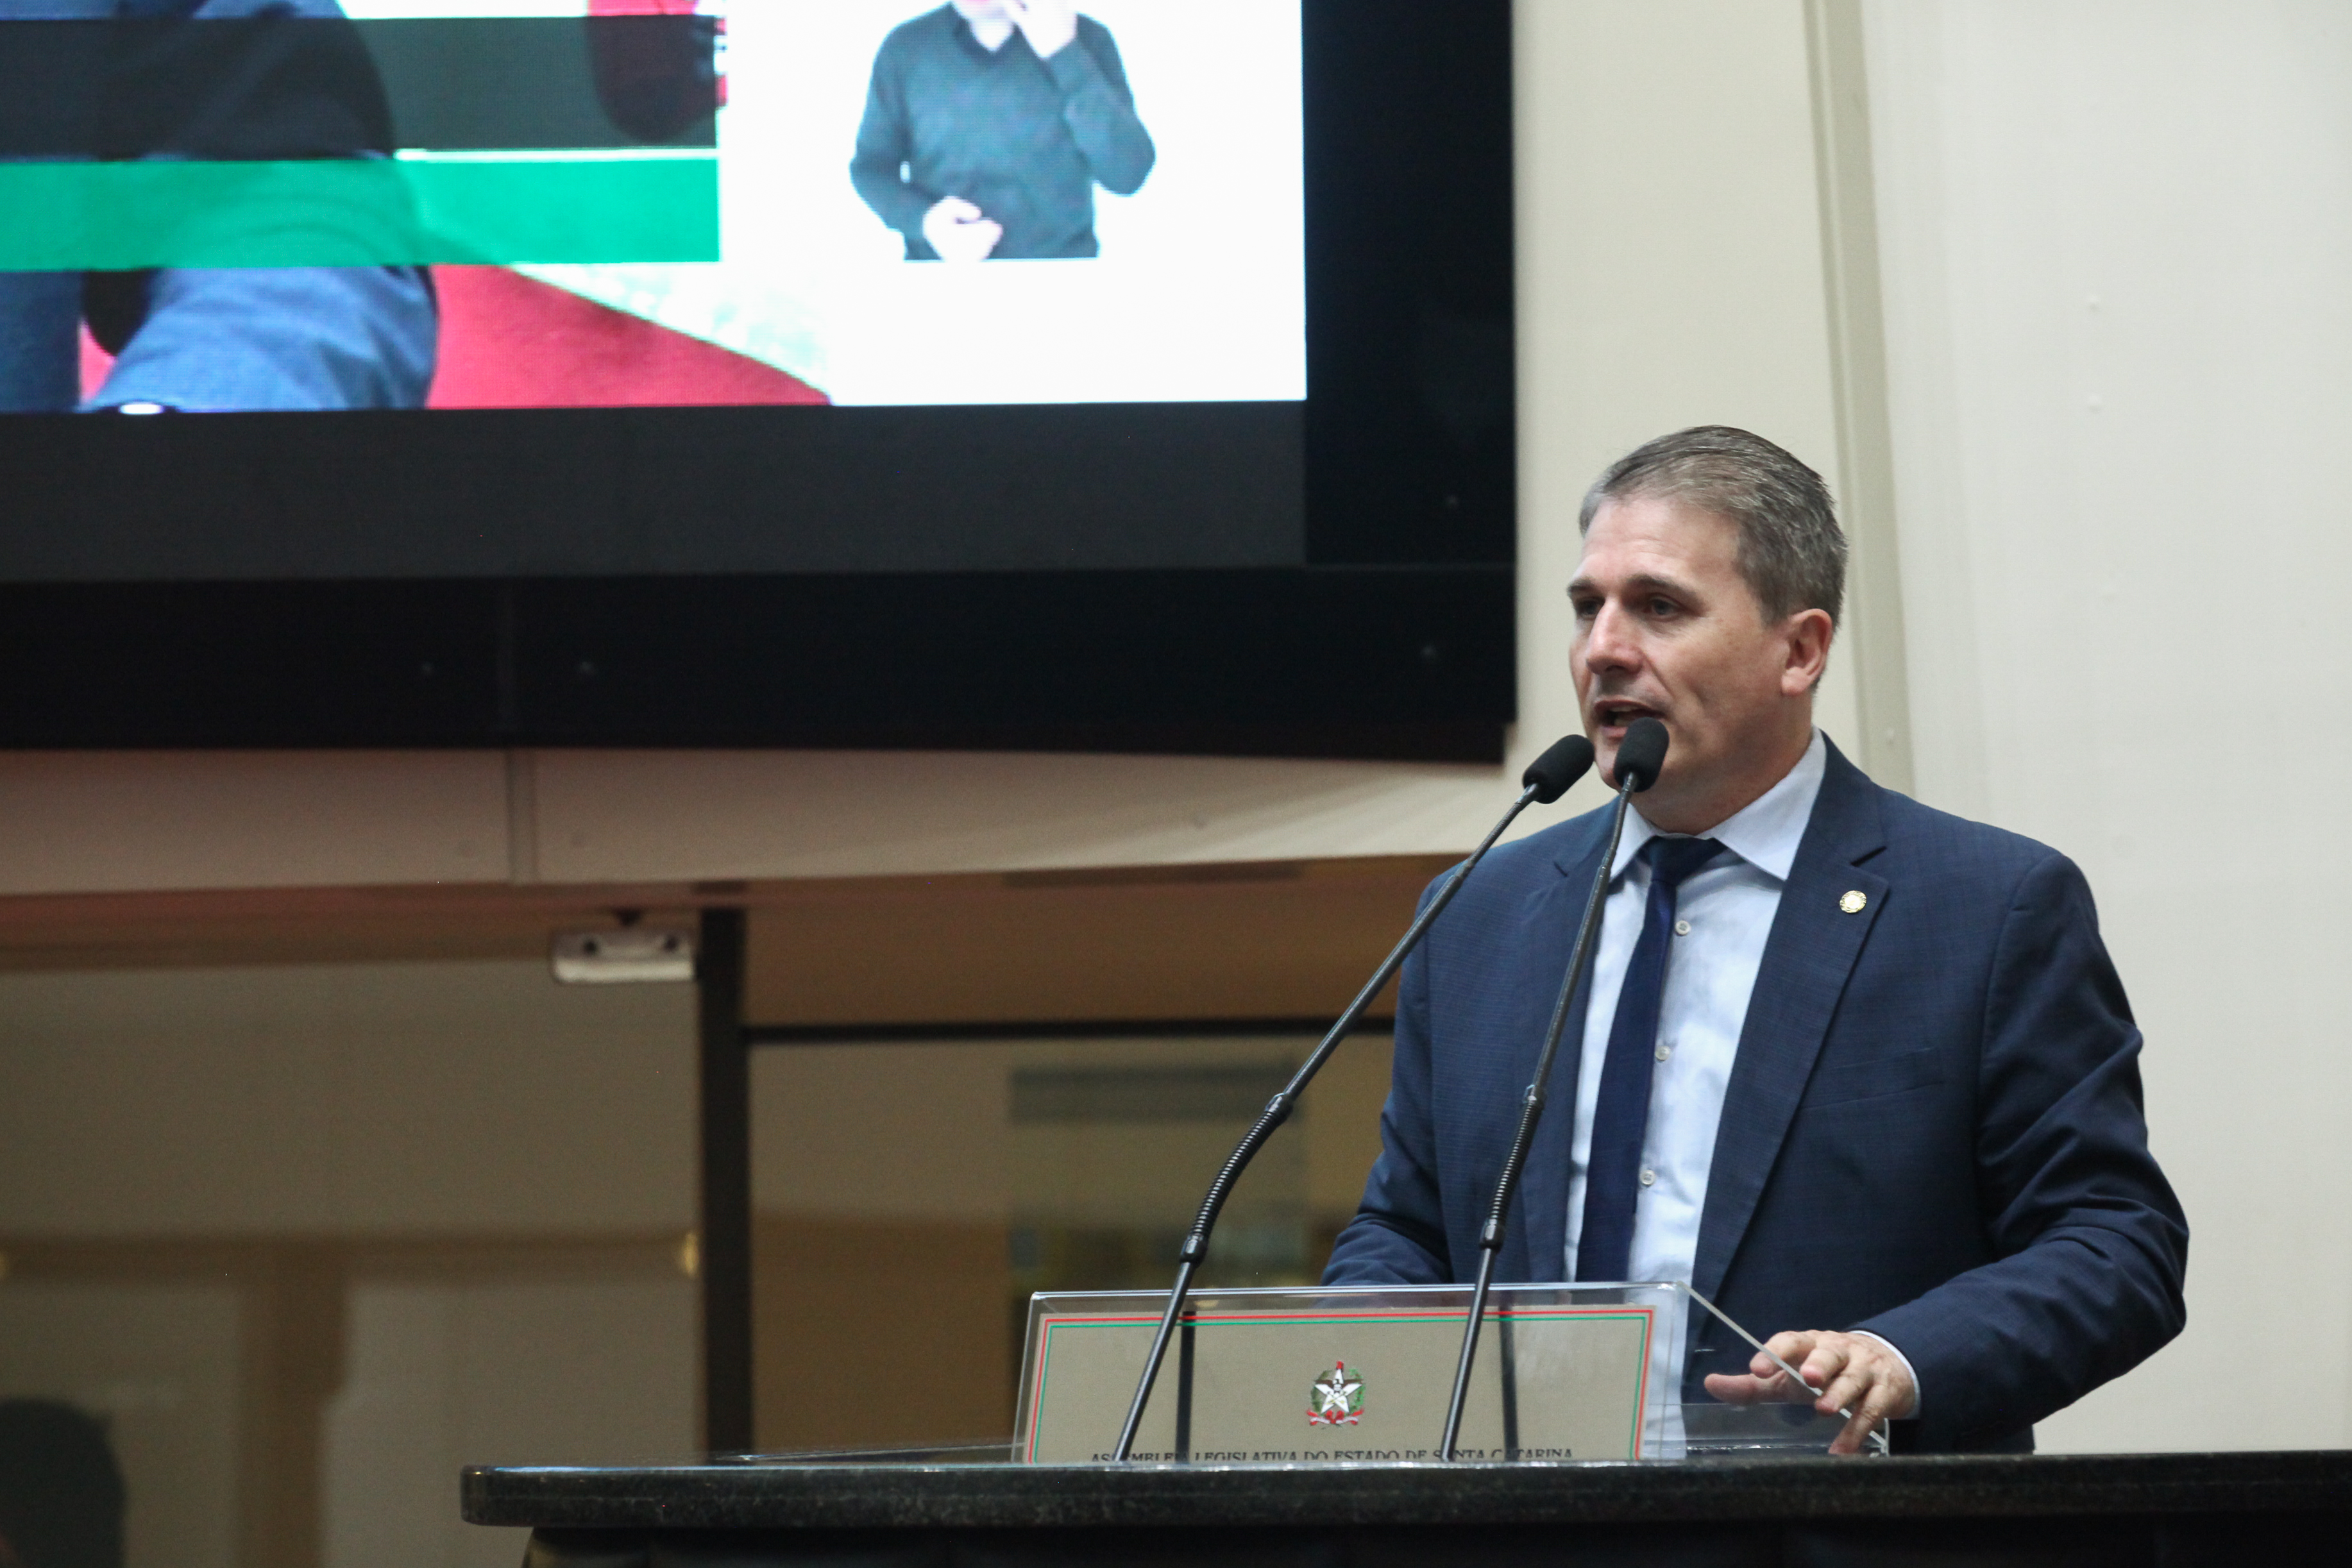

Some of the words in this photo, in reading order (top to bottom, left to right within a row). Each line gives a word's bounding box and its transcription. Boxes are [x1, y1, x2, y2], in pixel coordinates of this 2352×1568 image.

[1304, 1451, 1328, 1460] DO
[1334, 1450, 1400, 1460] ESTADO
[1405, 1449, 1427, 1459] DE
[1433, 1449, 1484, 1459] SNTA
